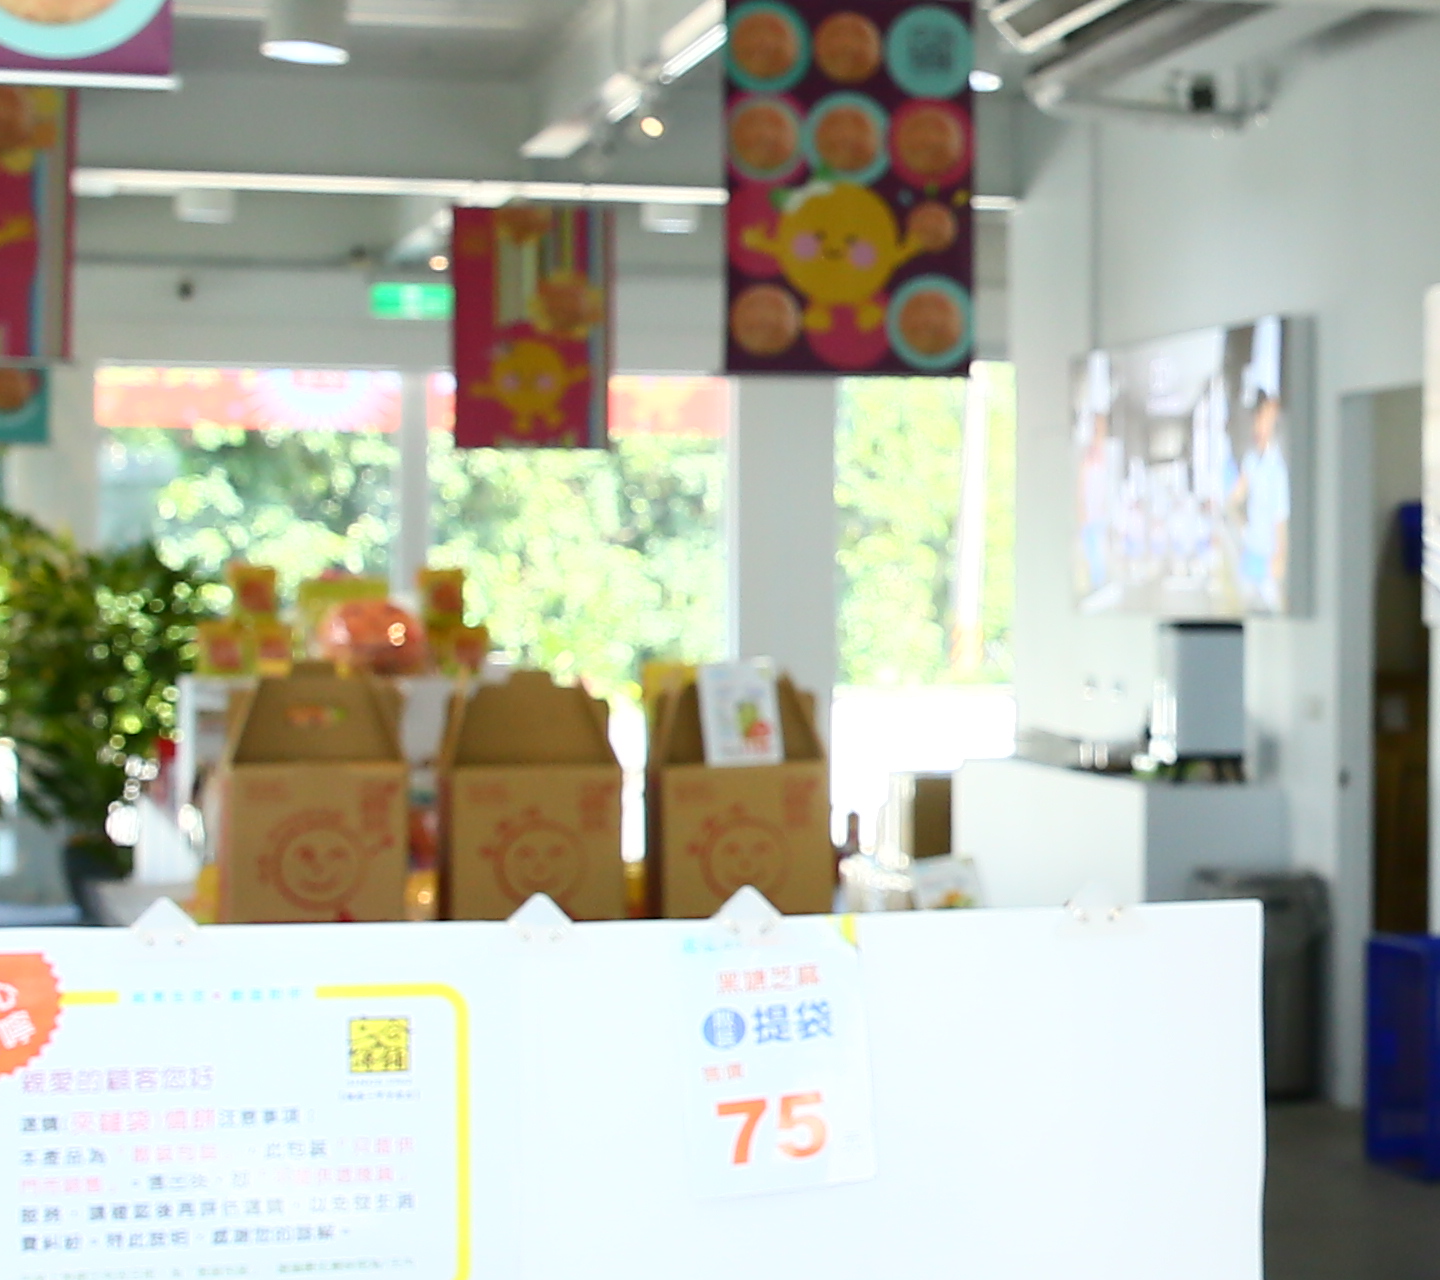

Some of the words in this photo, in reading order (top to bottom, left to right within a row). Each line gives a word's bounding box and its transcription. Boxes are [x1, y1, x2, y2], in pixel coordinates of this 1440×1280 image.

[754, 1000, 835, 1045] 提袋
[21, 1065, 215, 1095] 親愛的顧客您好
[716, 1091, 828, 1167] 75
